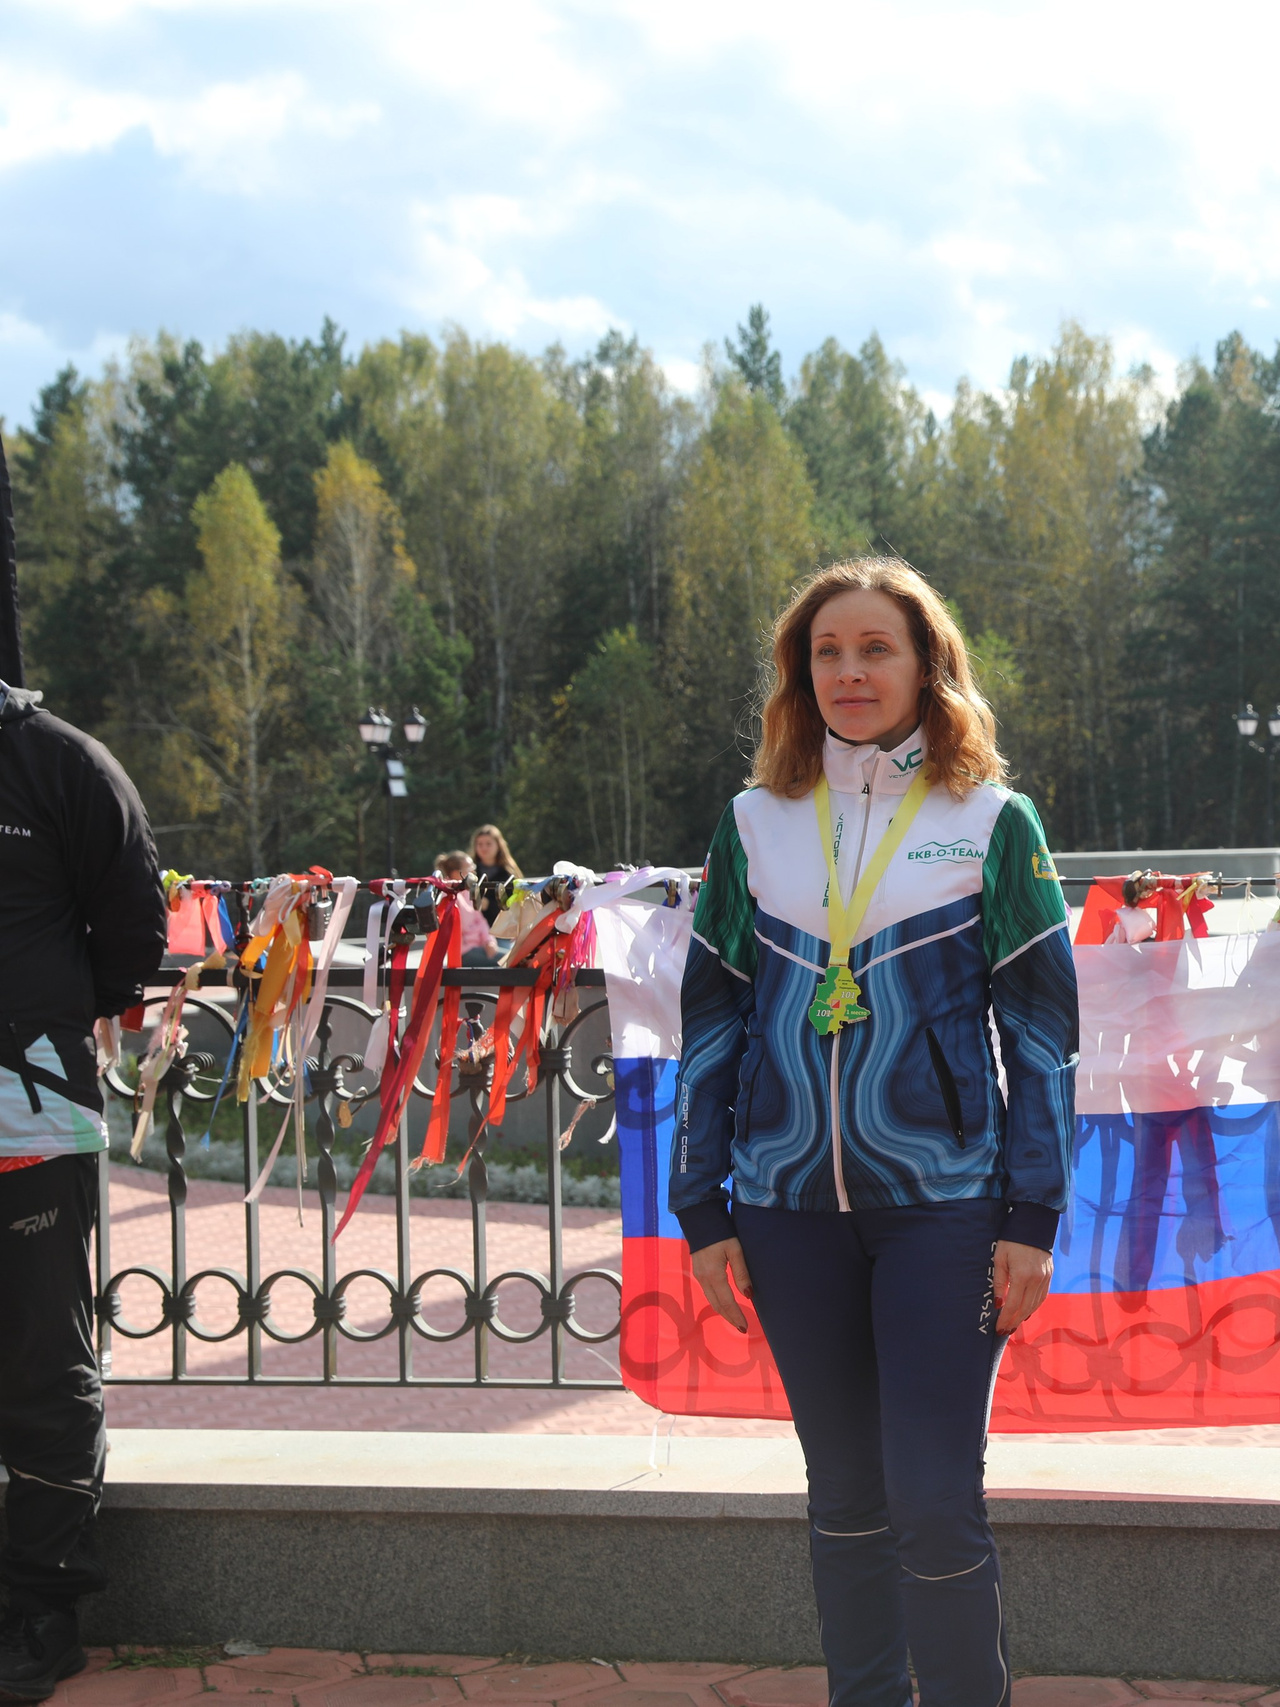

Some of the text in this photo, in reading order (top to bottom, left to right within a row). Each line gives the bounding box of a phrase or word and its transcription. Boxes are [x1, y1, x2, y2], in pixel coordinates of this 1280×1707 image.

[891, 747, 924, 772] VC
[832, 812, 844, 866] VICTORY
[907, 847, 985, 860] EKB-O-TEAM
[680, 1135, 688, 1174] CODE
